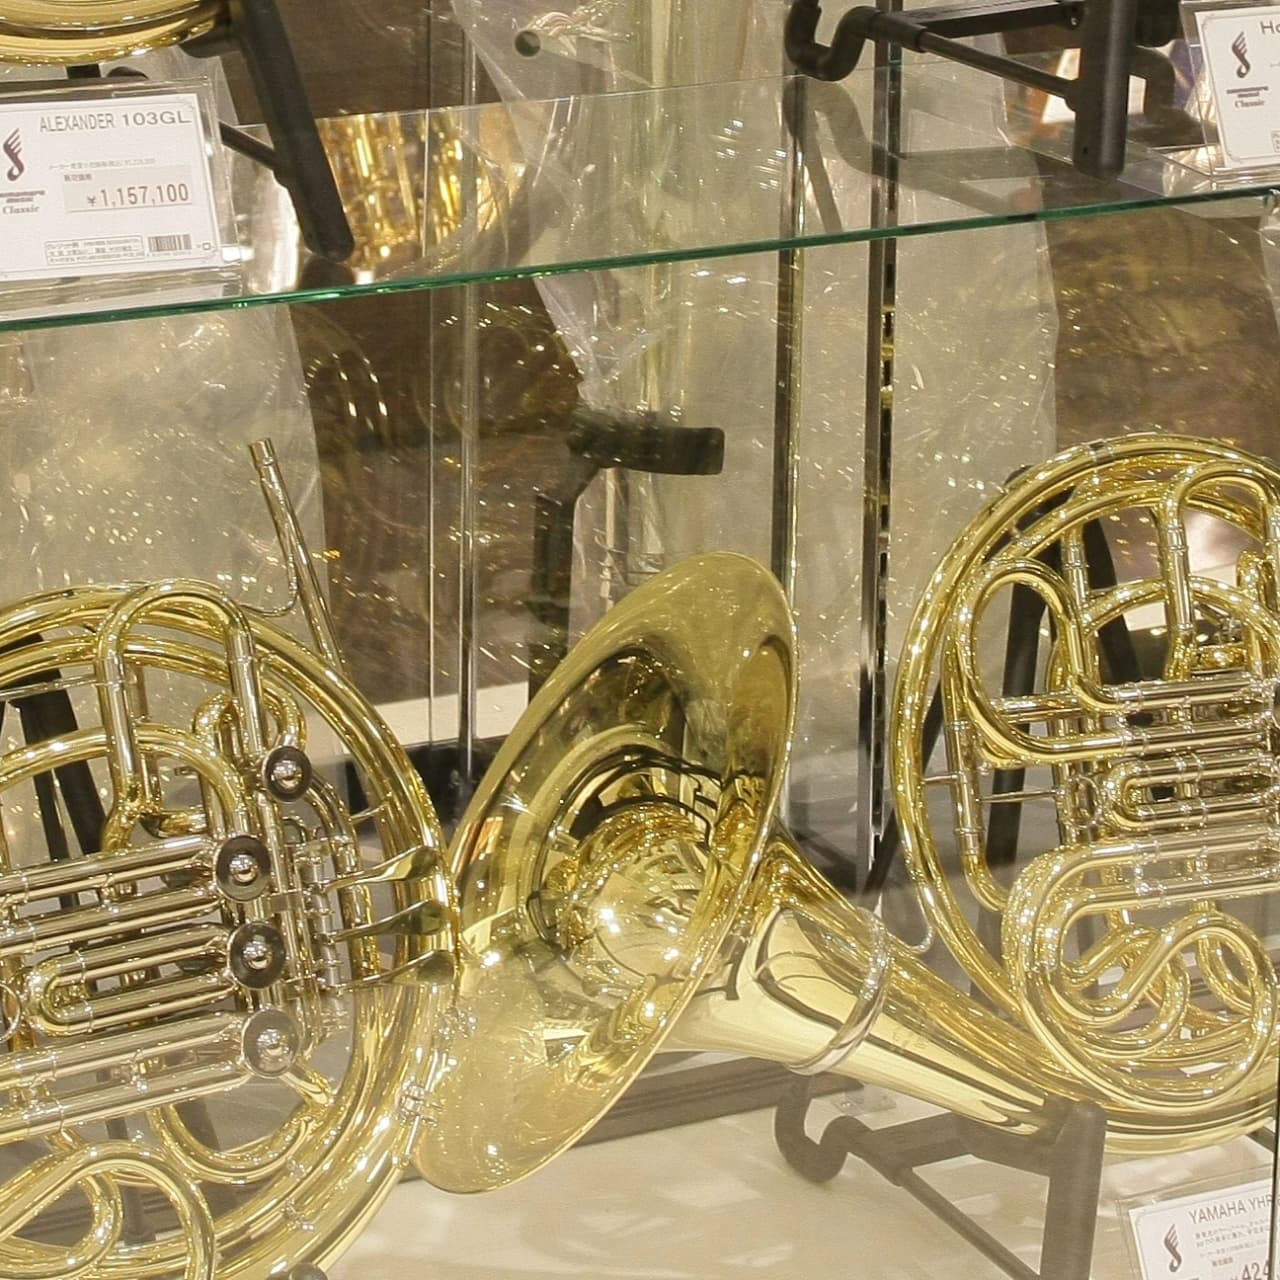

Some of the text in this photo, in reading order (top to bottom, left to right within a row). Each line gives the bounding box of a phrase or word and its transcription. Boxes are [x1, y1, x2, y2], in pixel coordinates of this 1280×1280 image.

[40, 111, 192, 133] ALEXANDER 103GL
[86, 183, 190, 208] ¥1,157,100
[2, 204, 40, 216] Classic
[1188, 1200, 1248, 1224] YAMAHA
